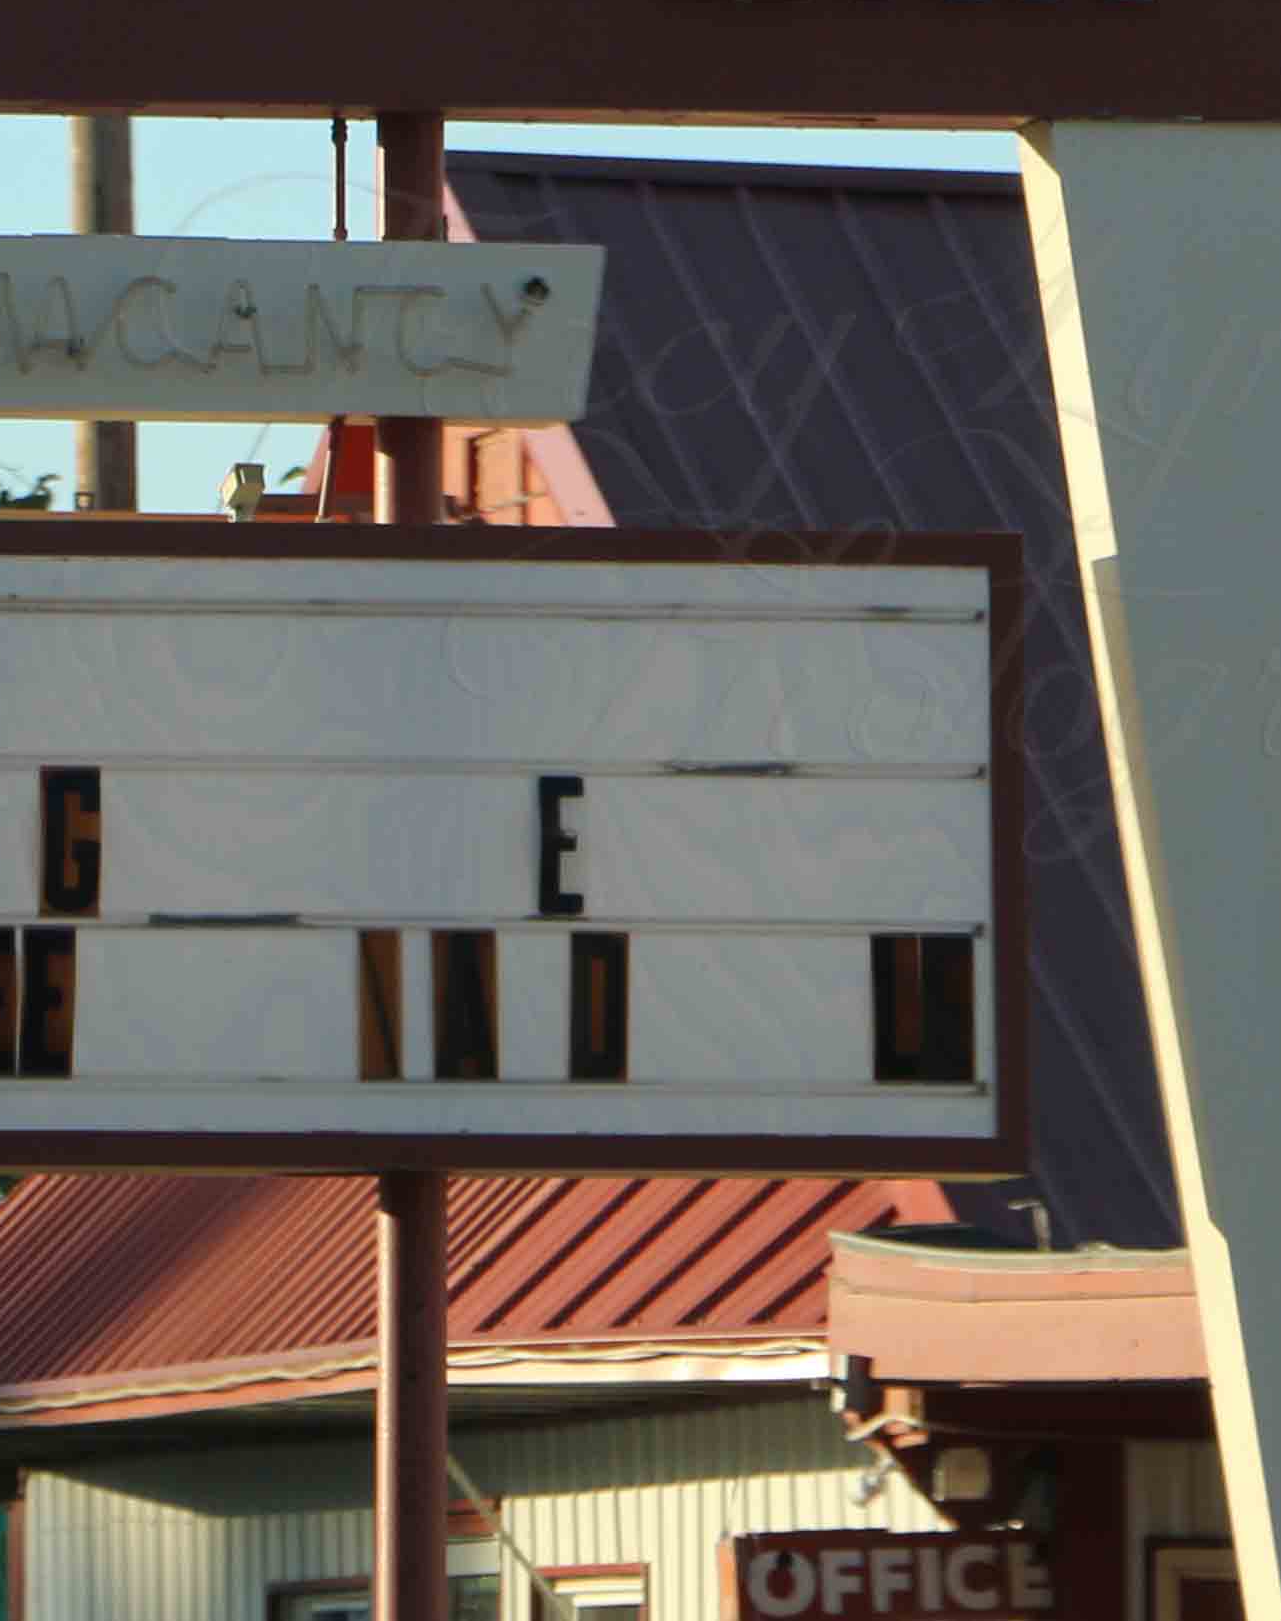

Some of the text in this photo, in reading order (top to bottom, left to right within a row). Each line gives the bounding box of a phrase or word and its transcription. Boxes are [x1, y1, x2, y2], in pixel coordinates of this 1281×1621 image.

[41, 766, 584, 915] G E
[746, 1543, 1054, 1617] OFFICE
